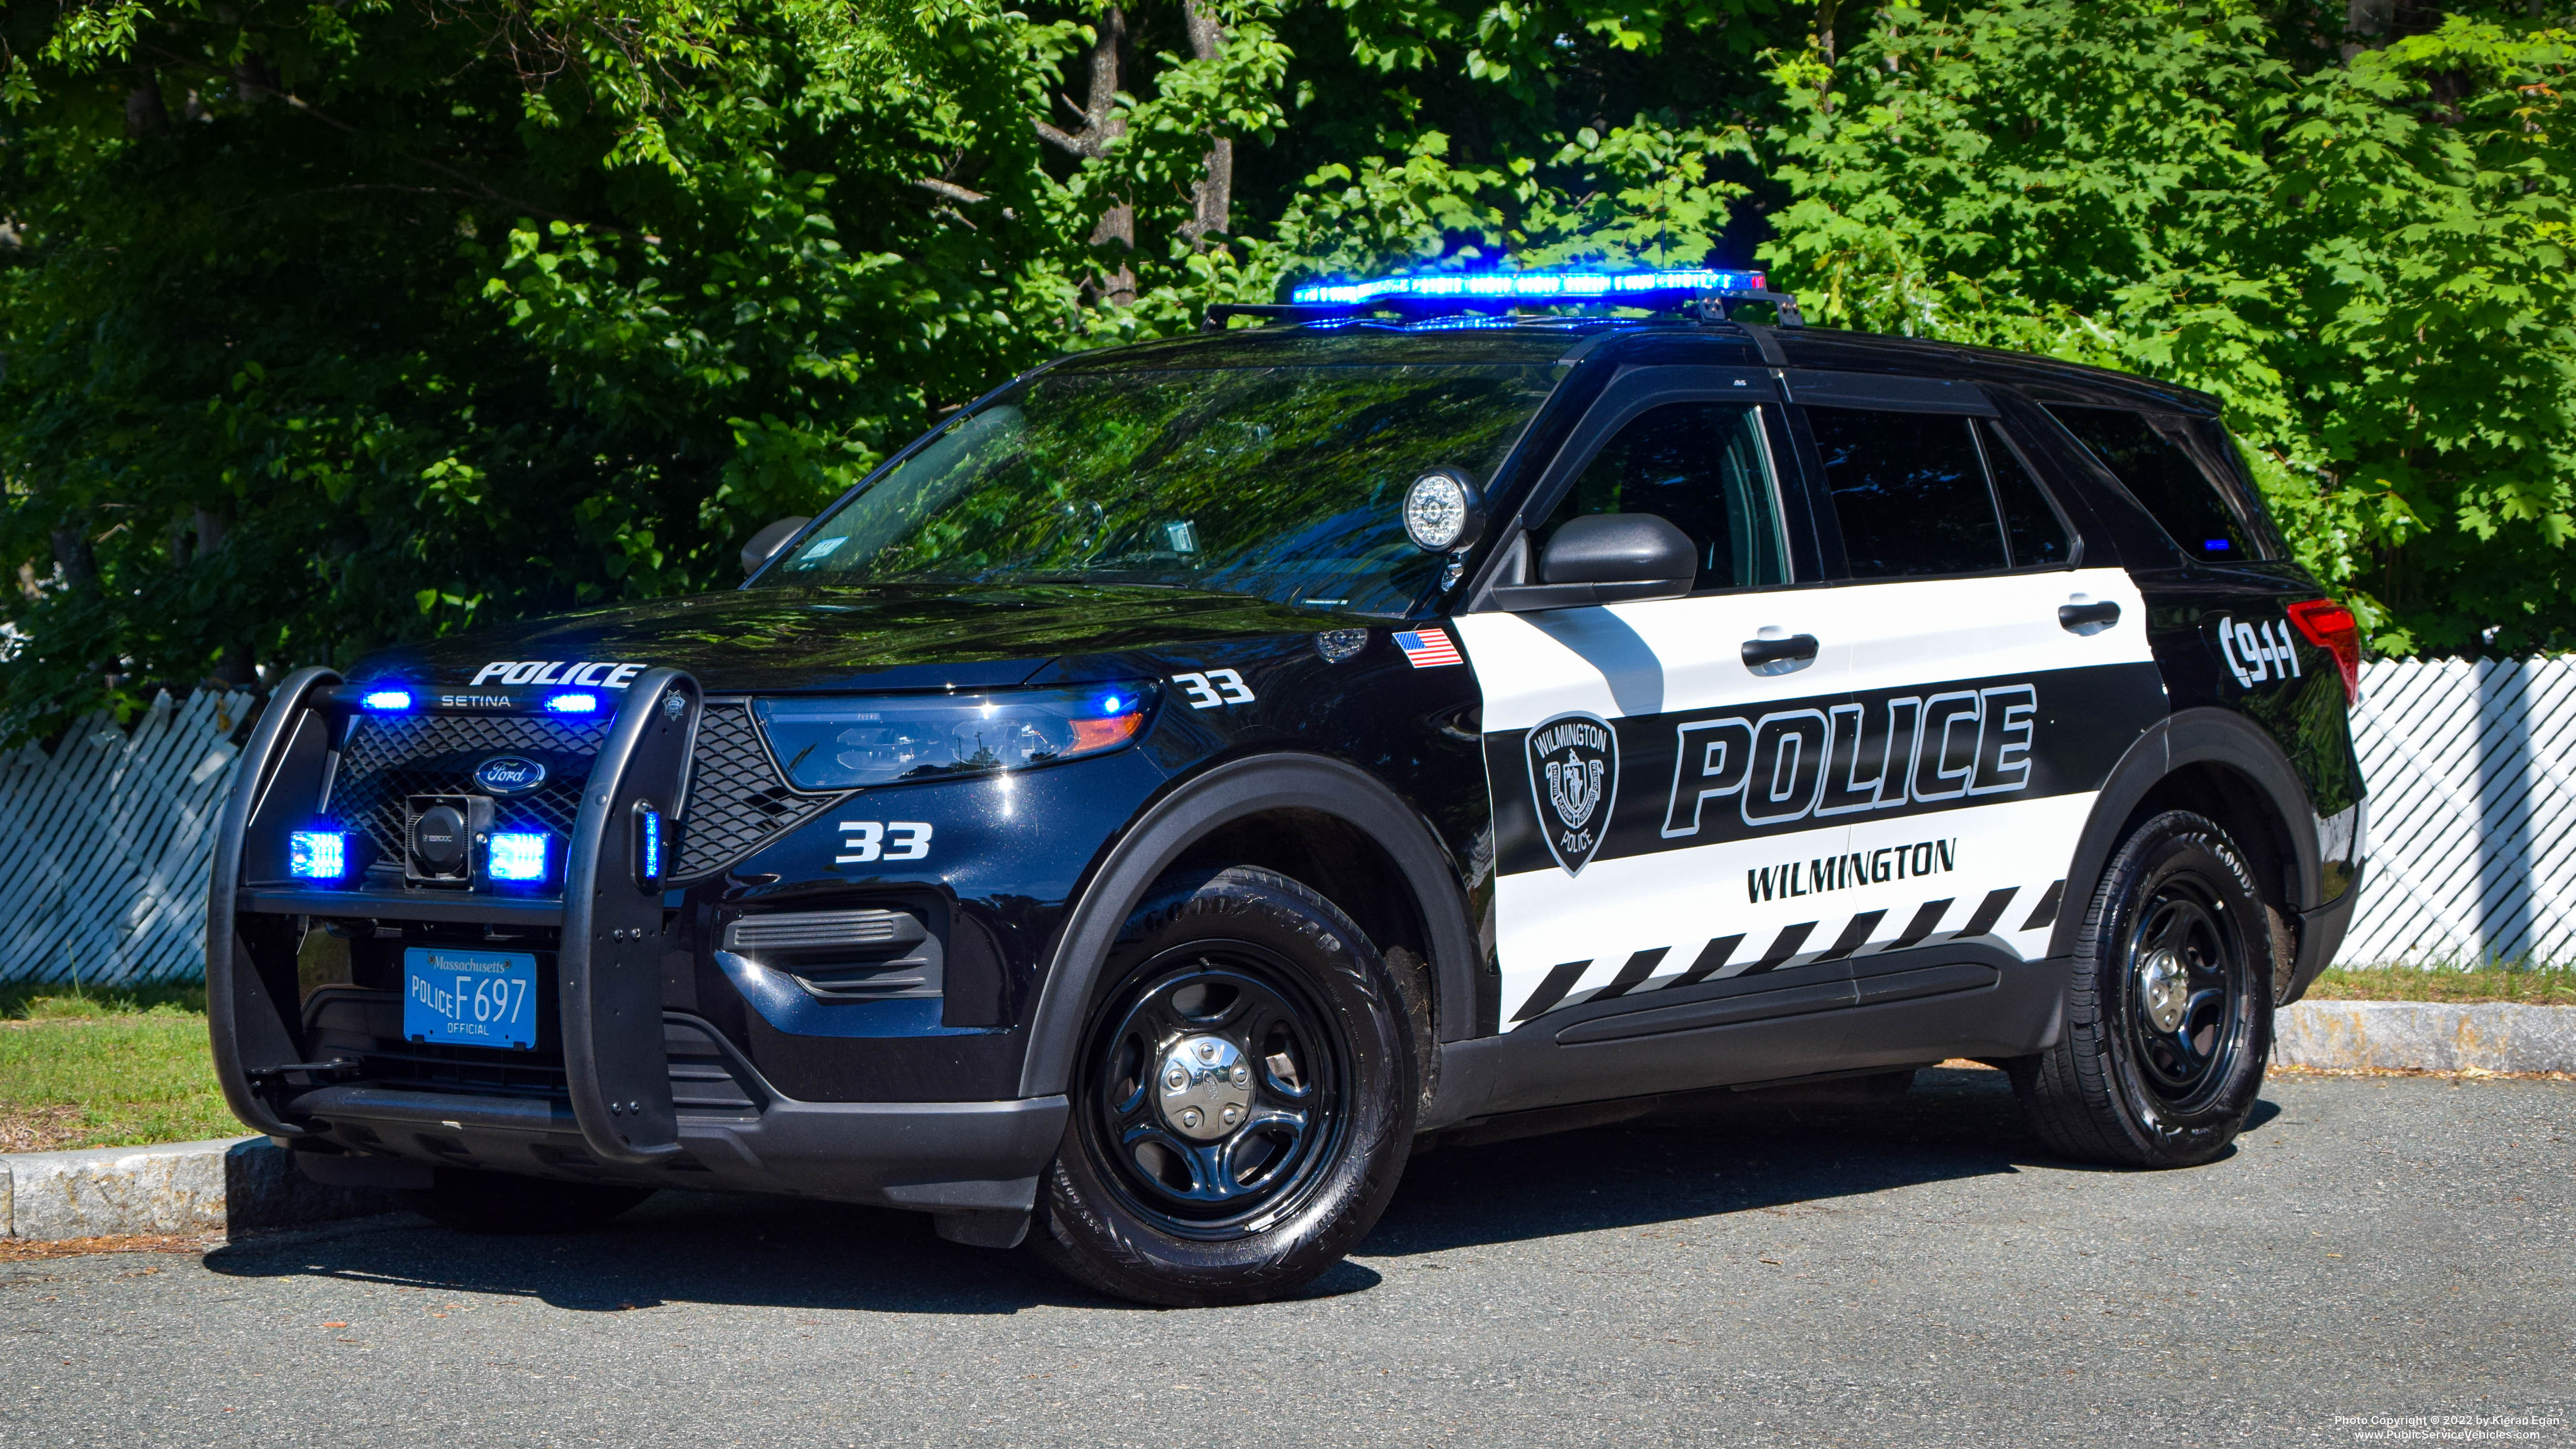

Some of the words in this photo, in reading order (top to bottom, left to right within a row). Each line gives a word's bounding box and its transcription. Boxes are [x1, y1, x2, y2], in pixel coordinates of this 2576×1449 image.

[469, 661, 647, 688] POLICE
[1171, 668, 1255, 709] 33
[442, 695, 511, 707] SETINA
[1534, 723, 1607, 759] WILMINGTON
[487, 762, 527, 782] Ford
[1661, 683, 2037, 839] POLICE
[835, 821, 933, 864] 33
[1560, 827, 1593, 853] POLICE
[1747, 837, 1957, 904] WILMINGTON
[434, 955, 505, 974] Massachusetts
[412, 974, 453, 1019] POLICE
[447, 1022, 489, 1036] OFFICIAL
